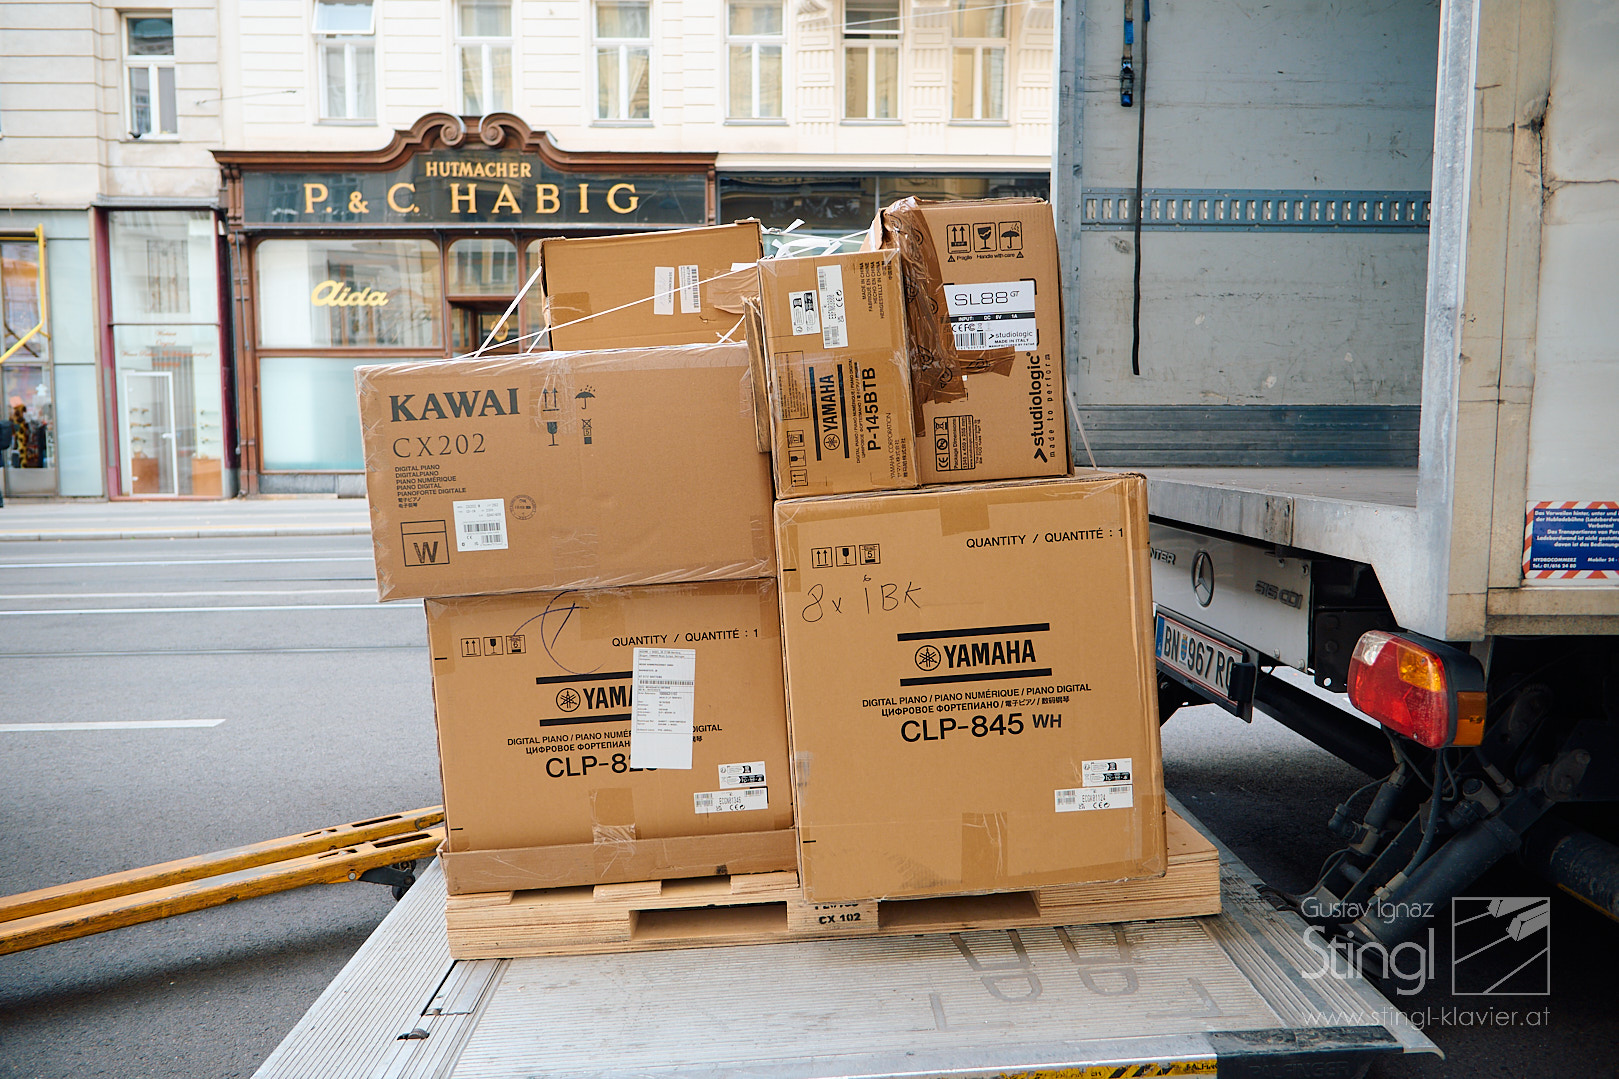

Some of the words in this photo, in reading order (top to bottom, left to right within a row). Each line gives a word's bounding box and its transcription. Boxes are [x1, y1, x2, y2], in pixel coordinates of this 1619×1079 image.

[426, 162, 531, 178] HUTMACHER
[304, 183, 333, 213] P.
[348, 191, 369, 213] &
[387, 183, 420, 213] C.
[450, 183, 639, 214] HABIG
[877, 284, 885, 318] HERGESTELLT
[954, 291, 1008, 306] SL88
[995, 331, 1033, 339] studiologic
[1045, 354, 1053, 402] perform
[389, 388, 520, 422] KAWAI
[819, 375, 838, 432] YAMAHA
[862, 368, 881, 450] P-145BTB
[1027, 355, 1044, 446] studiologic
[1046, 410, 1053, 421] to
[393, 433, 486, 458] CX202
[417, 475, 457, 484] NUMÉRIQUE
[966, 534, 1026, 549] QUANTITY
[1032, 533, 1039, 544] /
[1044, 527, 1103, 544] QUANTITÉ
[1118, 528, 1124, 538] 1
[413, 541, 439, 563] W
[1279, 589, 1304, 610] CDI
[612, 634, 668, 647] QUANTITY
[674, 633, 679, 643] /
[685, 628, 740, 642] QUANTITÉ
[754, 628, 759, 638] 1
[943, 639, 1037, 669] YAMAHA
[1164, 625, 1180, 662] BN
[1187, 637, 1214, 679] 967
[862, 698, 897, 708] DIGITAL
[899, 695, 928, 705] PIANO
[934, 692, 962, 702] PIANO
[965, 688, 1019, 700] NUMÉRIQUE
[1026, 685, 1055, 695] PIANO
[1056, 683, 1092, 693] DIGITAL
[881, 705, 934, 717] ЦИФРОВОЕ
[936, 700, 999, 713] ФОРТЕПИАНО
[507, 737, 541, 746] DIGITAL
[542, 734, 568, 744] PIANO
[575, 731, 602, 741] PIANO
[900, 712, 1024, 743] CLP-845
[1032, 713, 1062, 728] WH
[526, 744, 575, 755] ЦИФРОВОЕ
[545, 753, 658, 778] CLP-8
[819, 915, 835, 924] CX
[840, 912, 861, 922] 102
